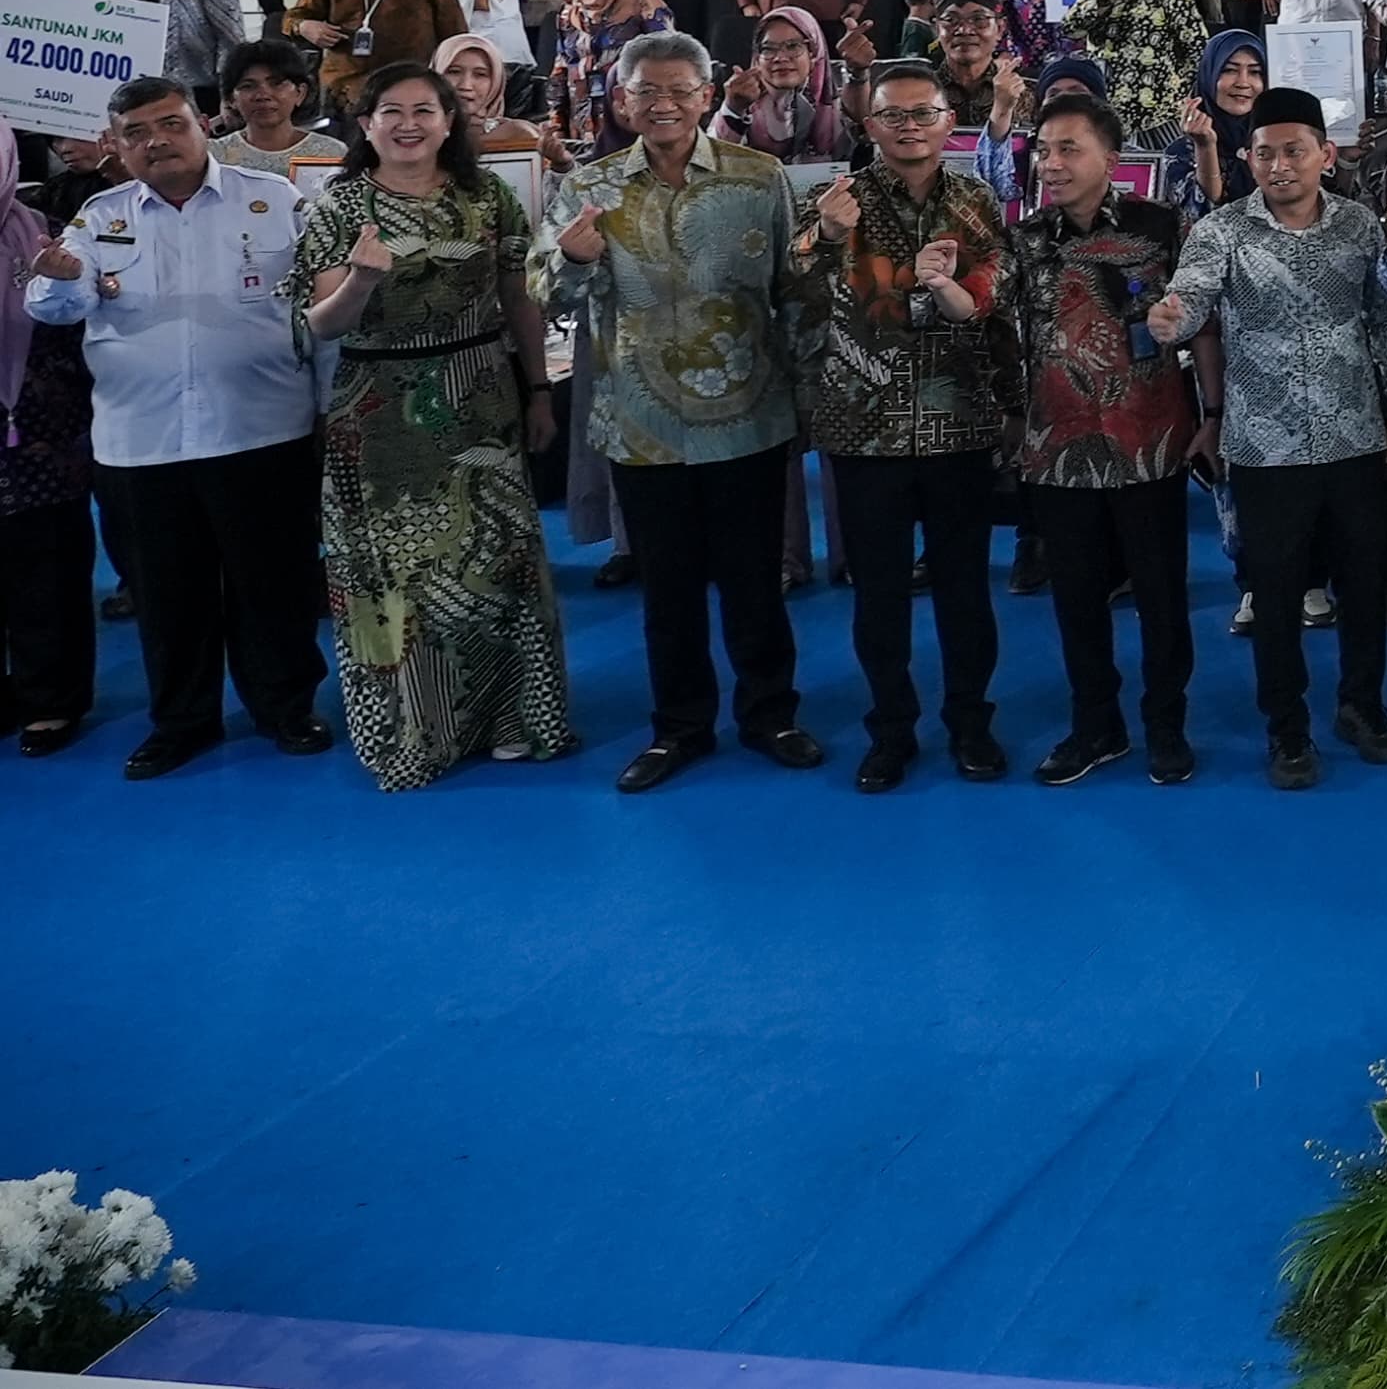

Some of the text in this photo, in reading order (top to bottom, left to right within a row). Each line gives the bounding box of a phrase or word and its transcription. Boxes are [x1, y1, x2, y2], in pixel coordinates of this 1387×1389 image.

[1, 12, 124, 45] SANTUNAN JKM
[6, 36, 133, 82] 42.000.000
[34, 87, 74, 104] SAUDI
